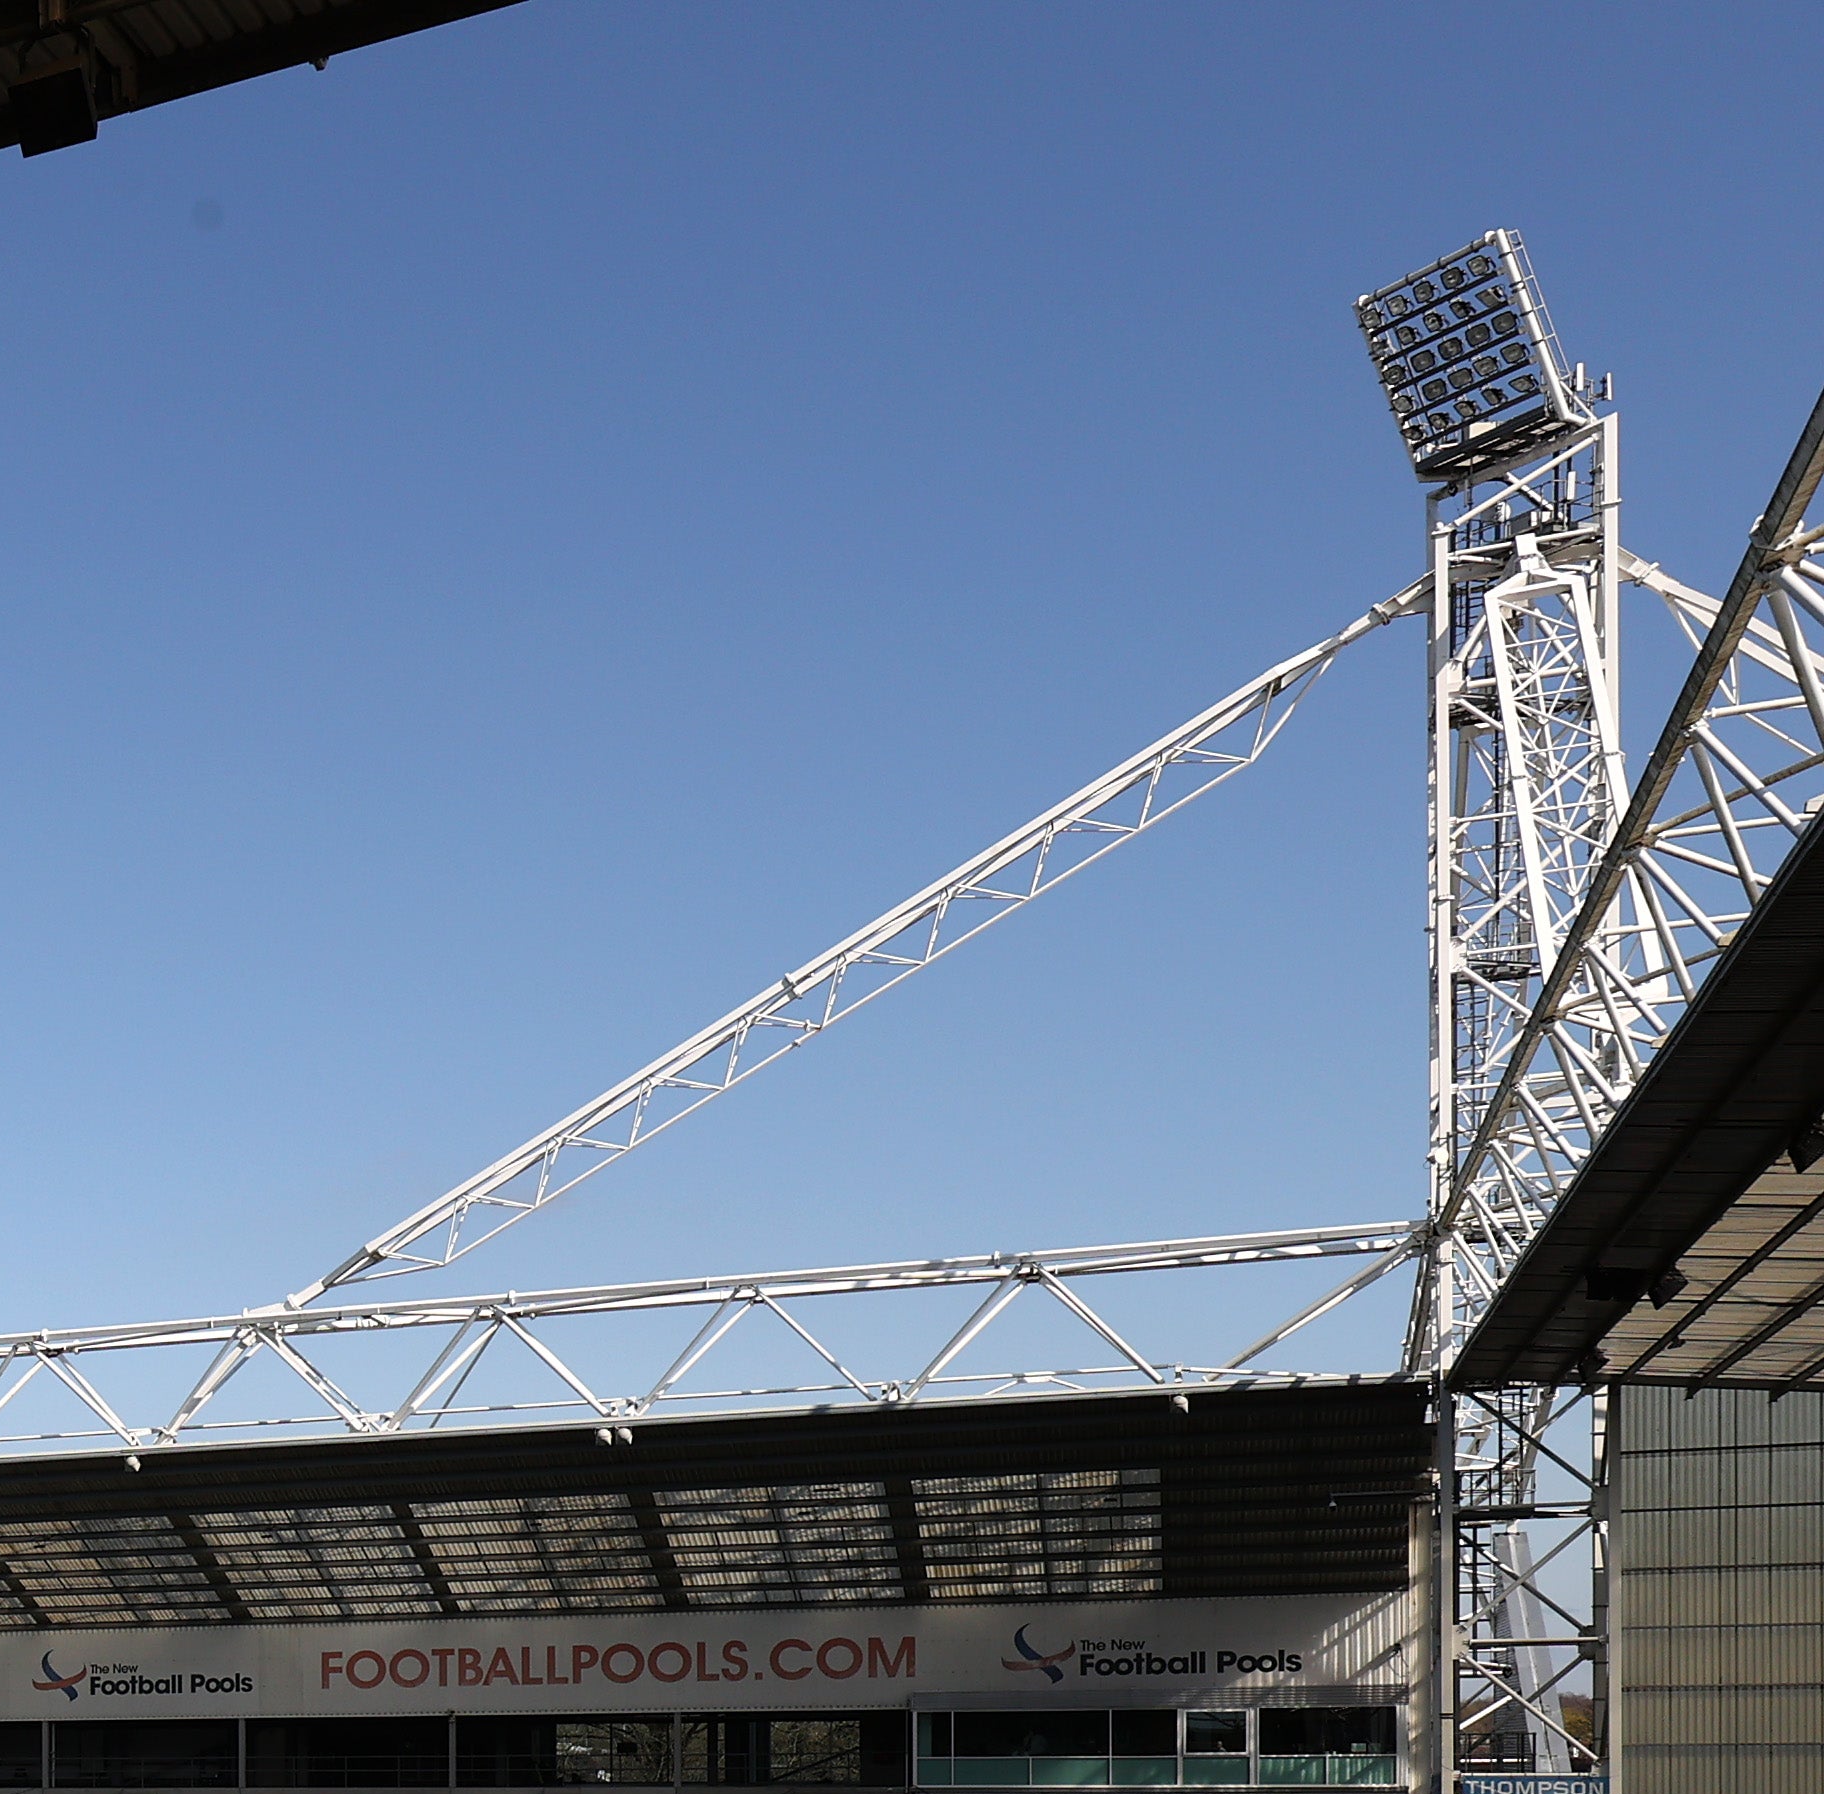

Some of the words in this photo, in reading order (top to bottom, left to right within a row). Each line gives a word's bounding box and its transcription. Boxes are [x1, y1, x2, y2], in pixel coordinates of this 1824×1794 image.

[1080, 1640, 1105, 1651] The
[1110, 1639, 1145, 1651] New
[90, 1664, 108, 1674] The
[111, 1663, 138, 1674] New
[321, 1636, 916, 1690] FOOTBALLPOOLS.COM
[1080, 1651, 1205, 1677] Football
[1217, 1649, 1302, 1673] Pools
[90, 1674, 183, 1696] Football
[190, 1672, 253, 1694] Pools
